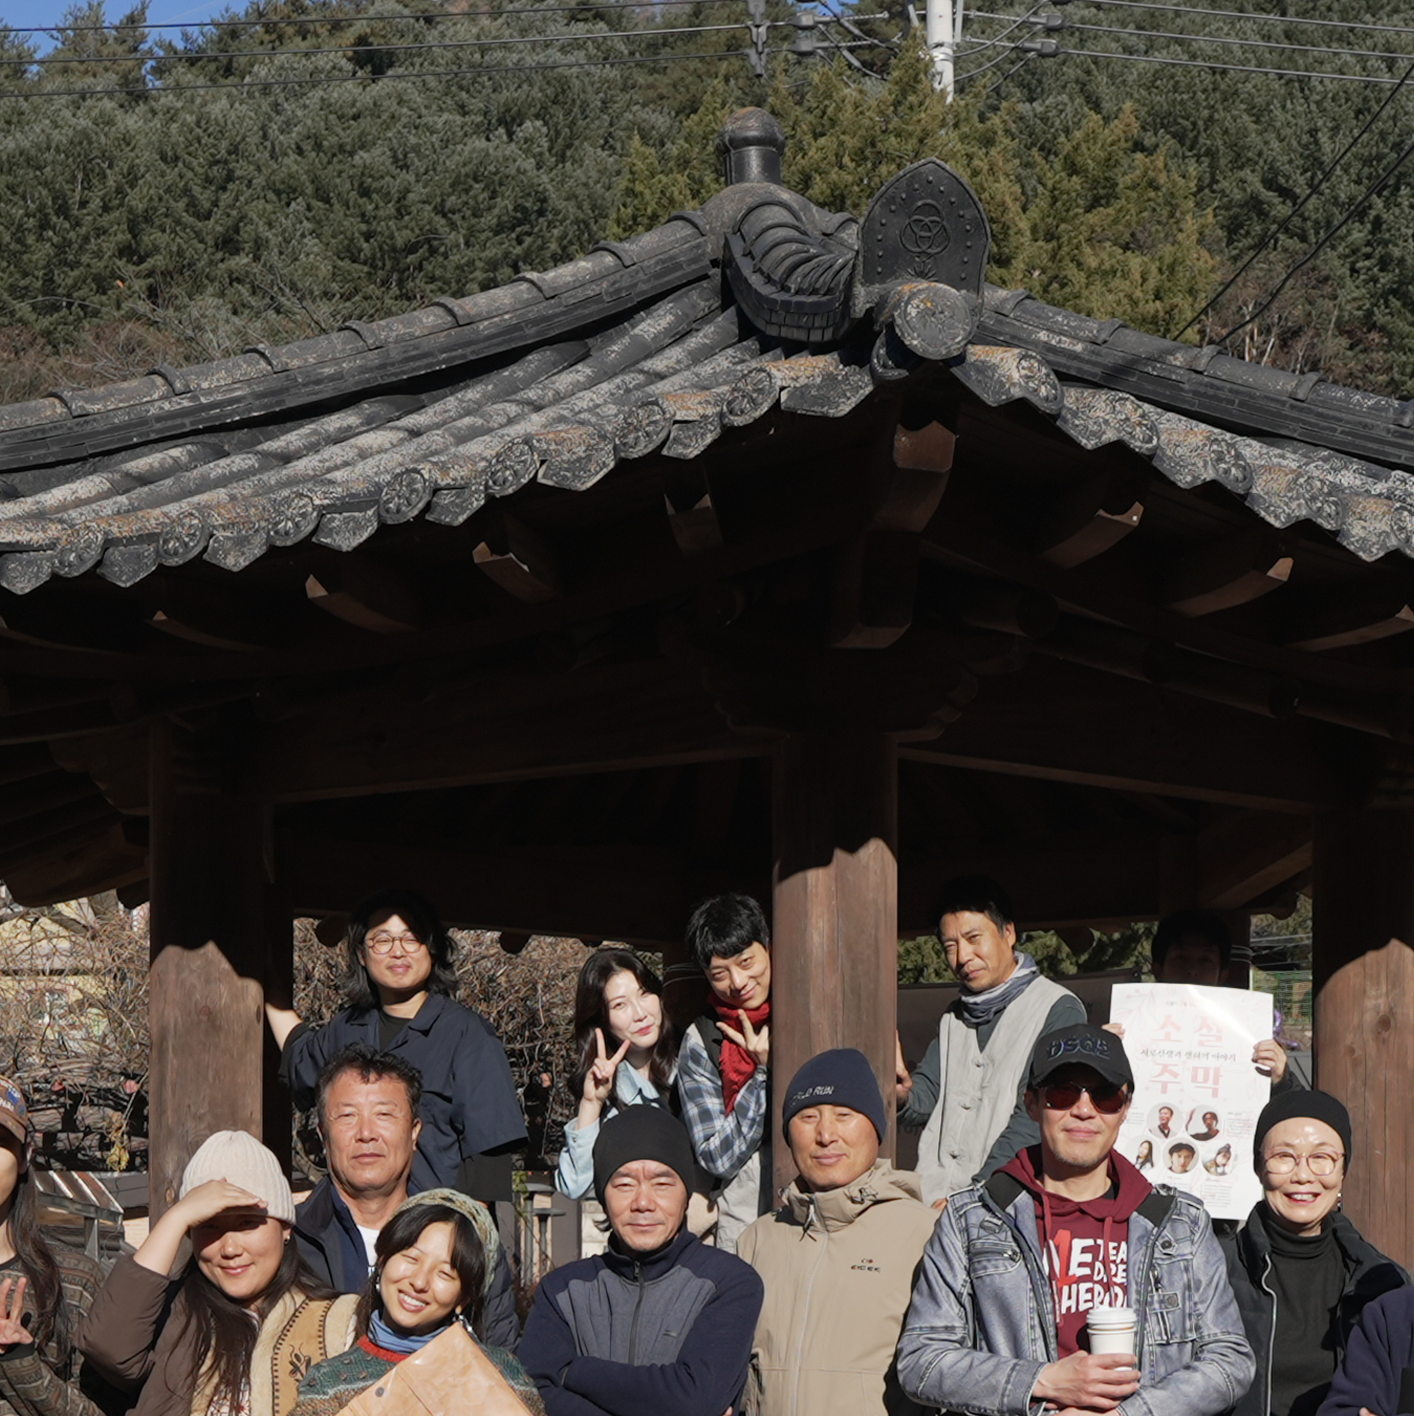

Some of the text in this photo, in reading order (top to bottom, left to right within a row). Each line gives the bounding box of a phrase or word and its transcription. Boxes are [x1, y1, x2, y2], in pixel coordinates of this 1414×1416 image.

[1150, 1013, 1224, 1048] 소설
[813, 1086, 834, 1096] RUN
[1148, 1061, 1223, 1099] 주막
